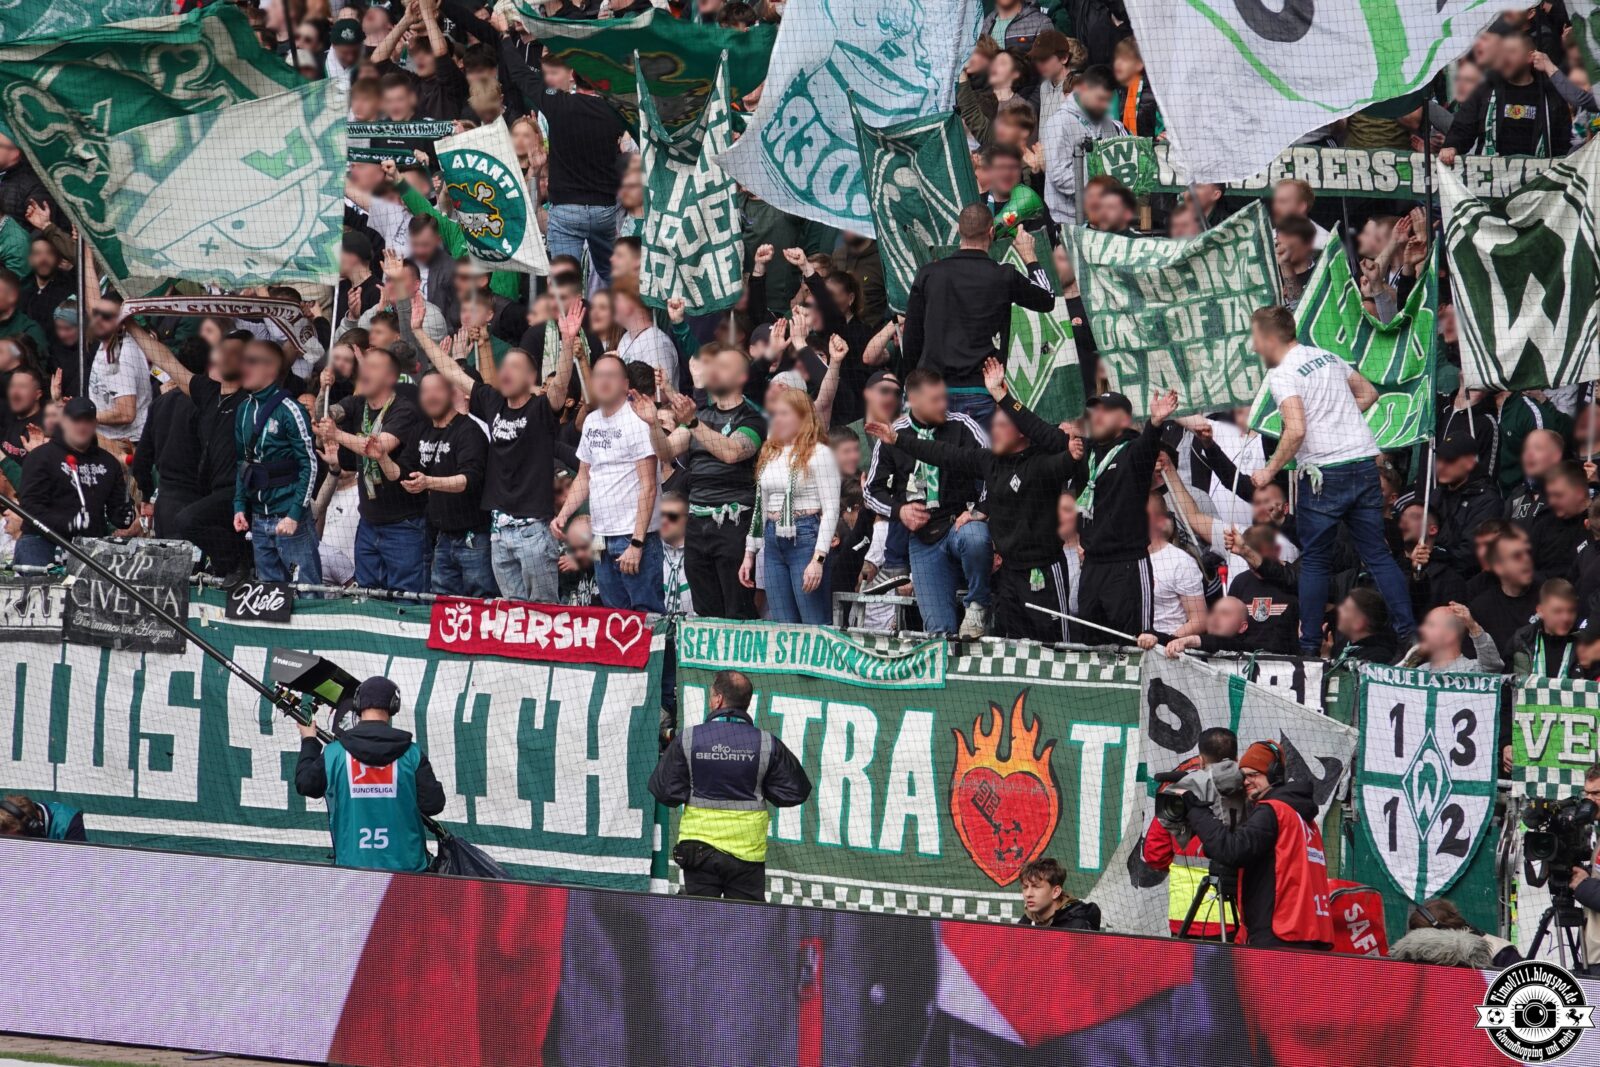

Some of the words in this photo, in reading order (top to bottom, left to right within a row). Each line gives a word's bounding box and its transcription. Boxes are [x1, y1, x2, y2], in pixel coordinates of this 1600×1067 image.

[452, 153, 519, 199] AVANTI
[1164, 301, 1209, 341] OF
[107, 551, 154, 580] RIP
[232, 583, 285, 616] Kiste
[479, 606, 600, 649] HERSH
[683, 626, 769, 664] SEKTION
[774, 631, 939, 682] STADIONVERBOT
[1366, 666, 1415, 686] NIQUE
[1417, 672, 1442, 689] LA
[1442, 674, 1500, 691] POLICE
[1389, 703, 1406, 758] 1
[1450, 708, 1478, 767] 3
[695, 752, 756, 762] SECURITY
[359, 827, 389, 850] 25
[1384, 796, 1400, 852] 1
[1436, 803, 1471, 858] 2
